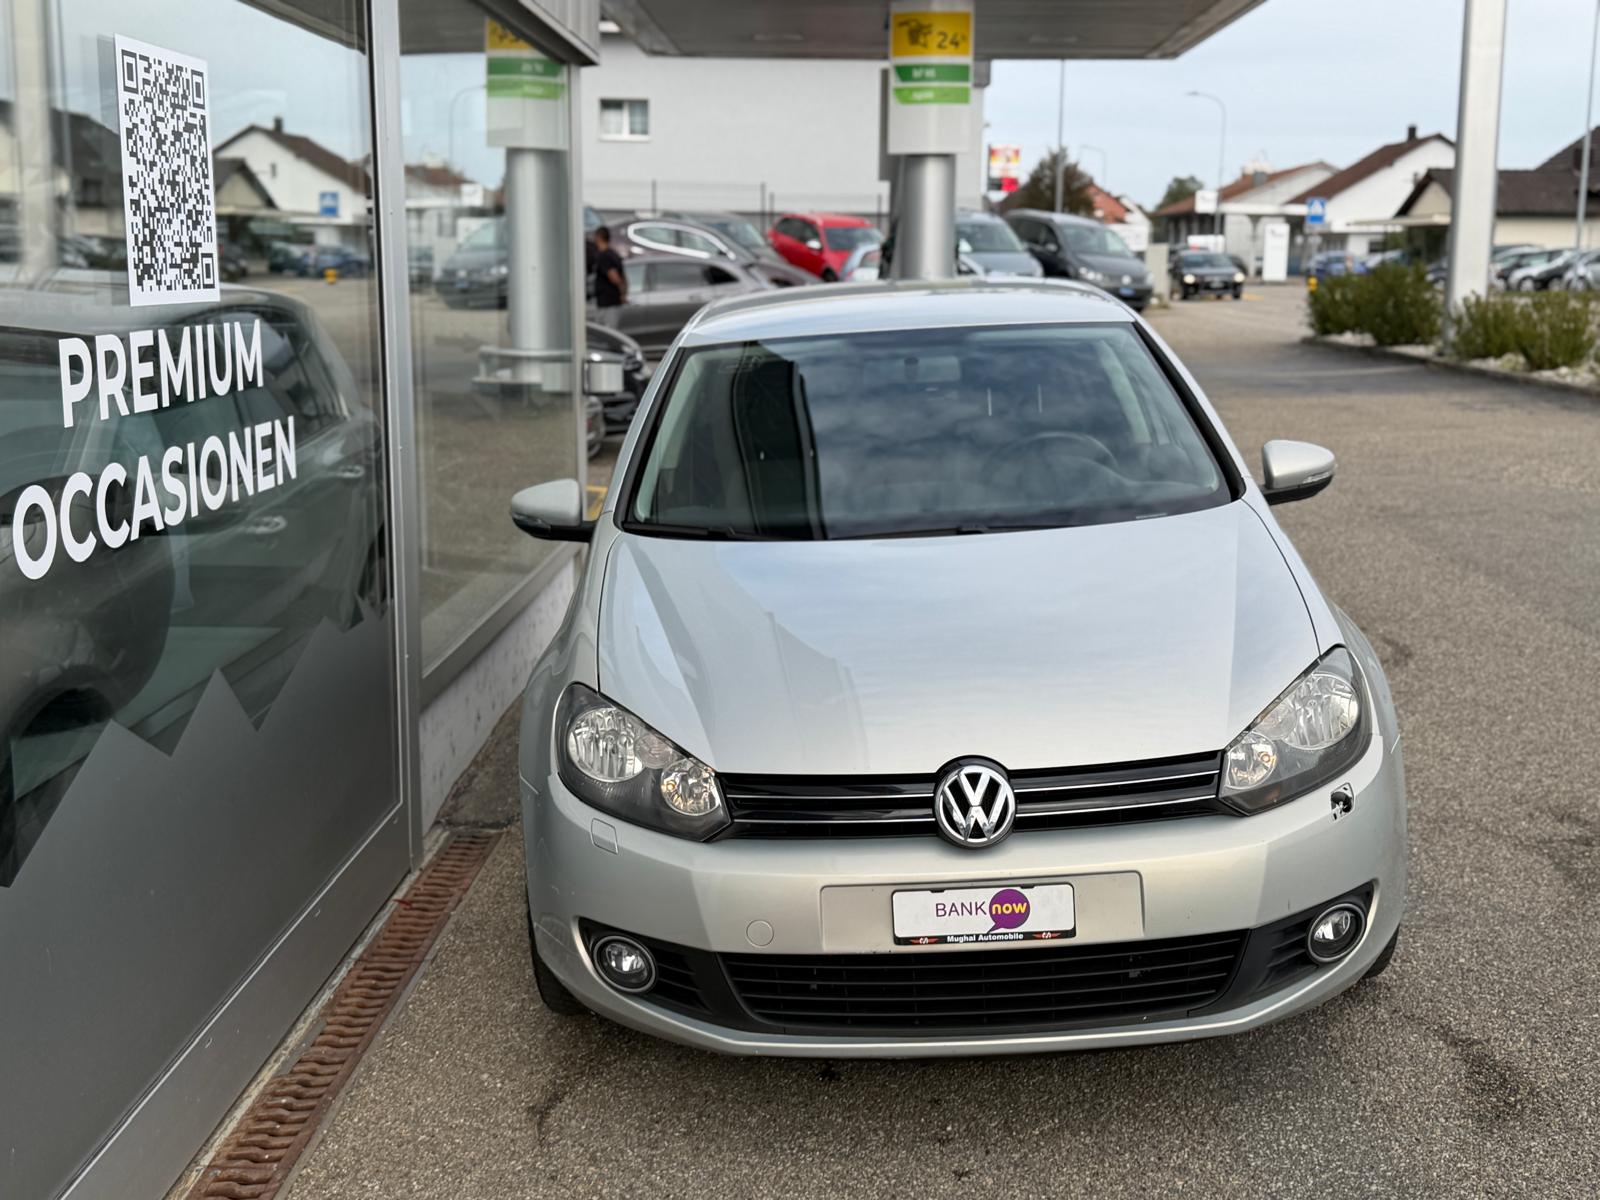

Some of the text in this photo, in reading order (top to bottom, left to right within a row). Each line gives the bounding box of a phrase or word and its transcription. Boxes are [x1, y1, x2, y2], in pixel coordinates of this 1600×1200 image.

[58, 318, 264, 428] PREMIUM
[12, 415, 297, 580] OCCASIONEN
[935, 901, 1027, 918] BANK now
[946, 932, 1024, 945] Mughal Automobile
